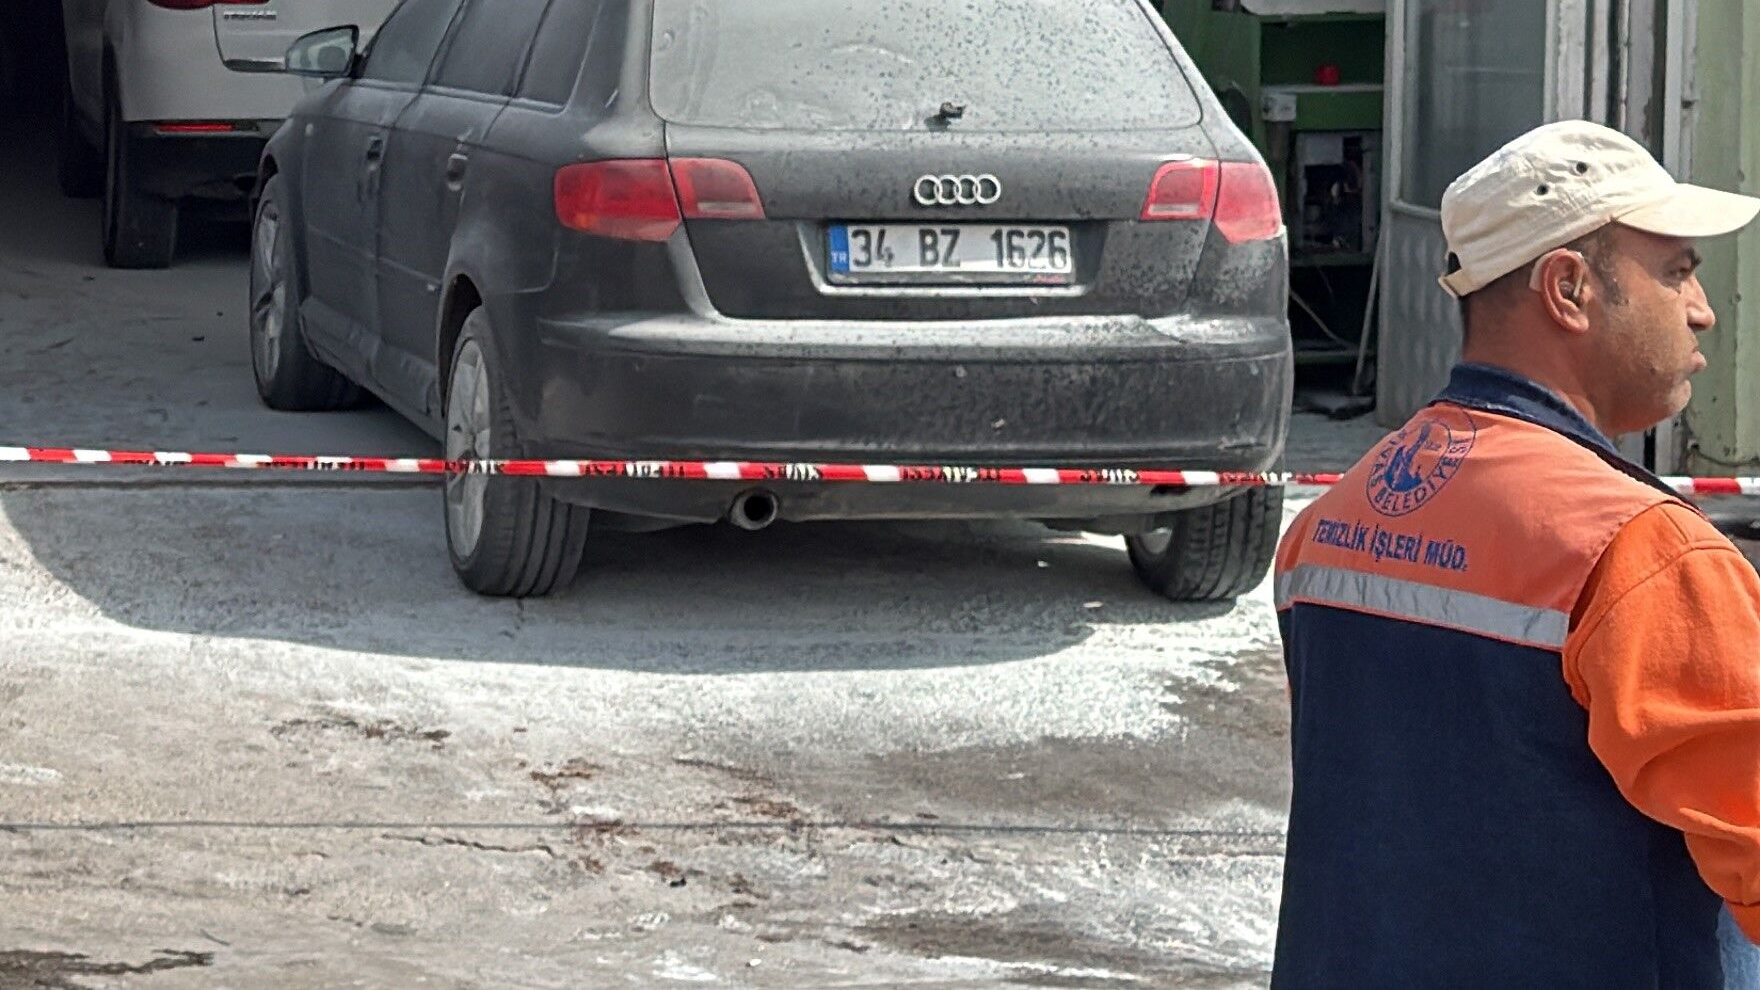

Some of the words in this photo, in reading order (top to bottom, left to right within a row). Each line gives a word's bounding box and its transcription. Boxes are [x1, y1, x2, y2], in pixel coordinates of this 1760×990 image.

[851, 228, 894, 268] 34
[918, 228, 962, 268] BZ
[990, 228, 1068, 270] 1626
